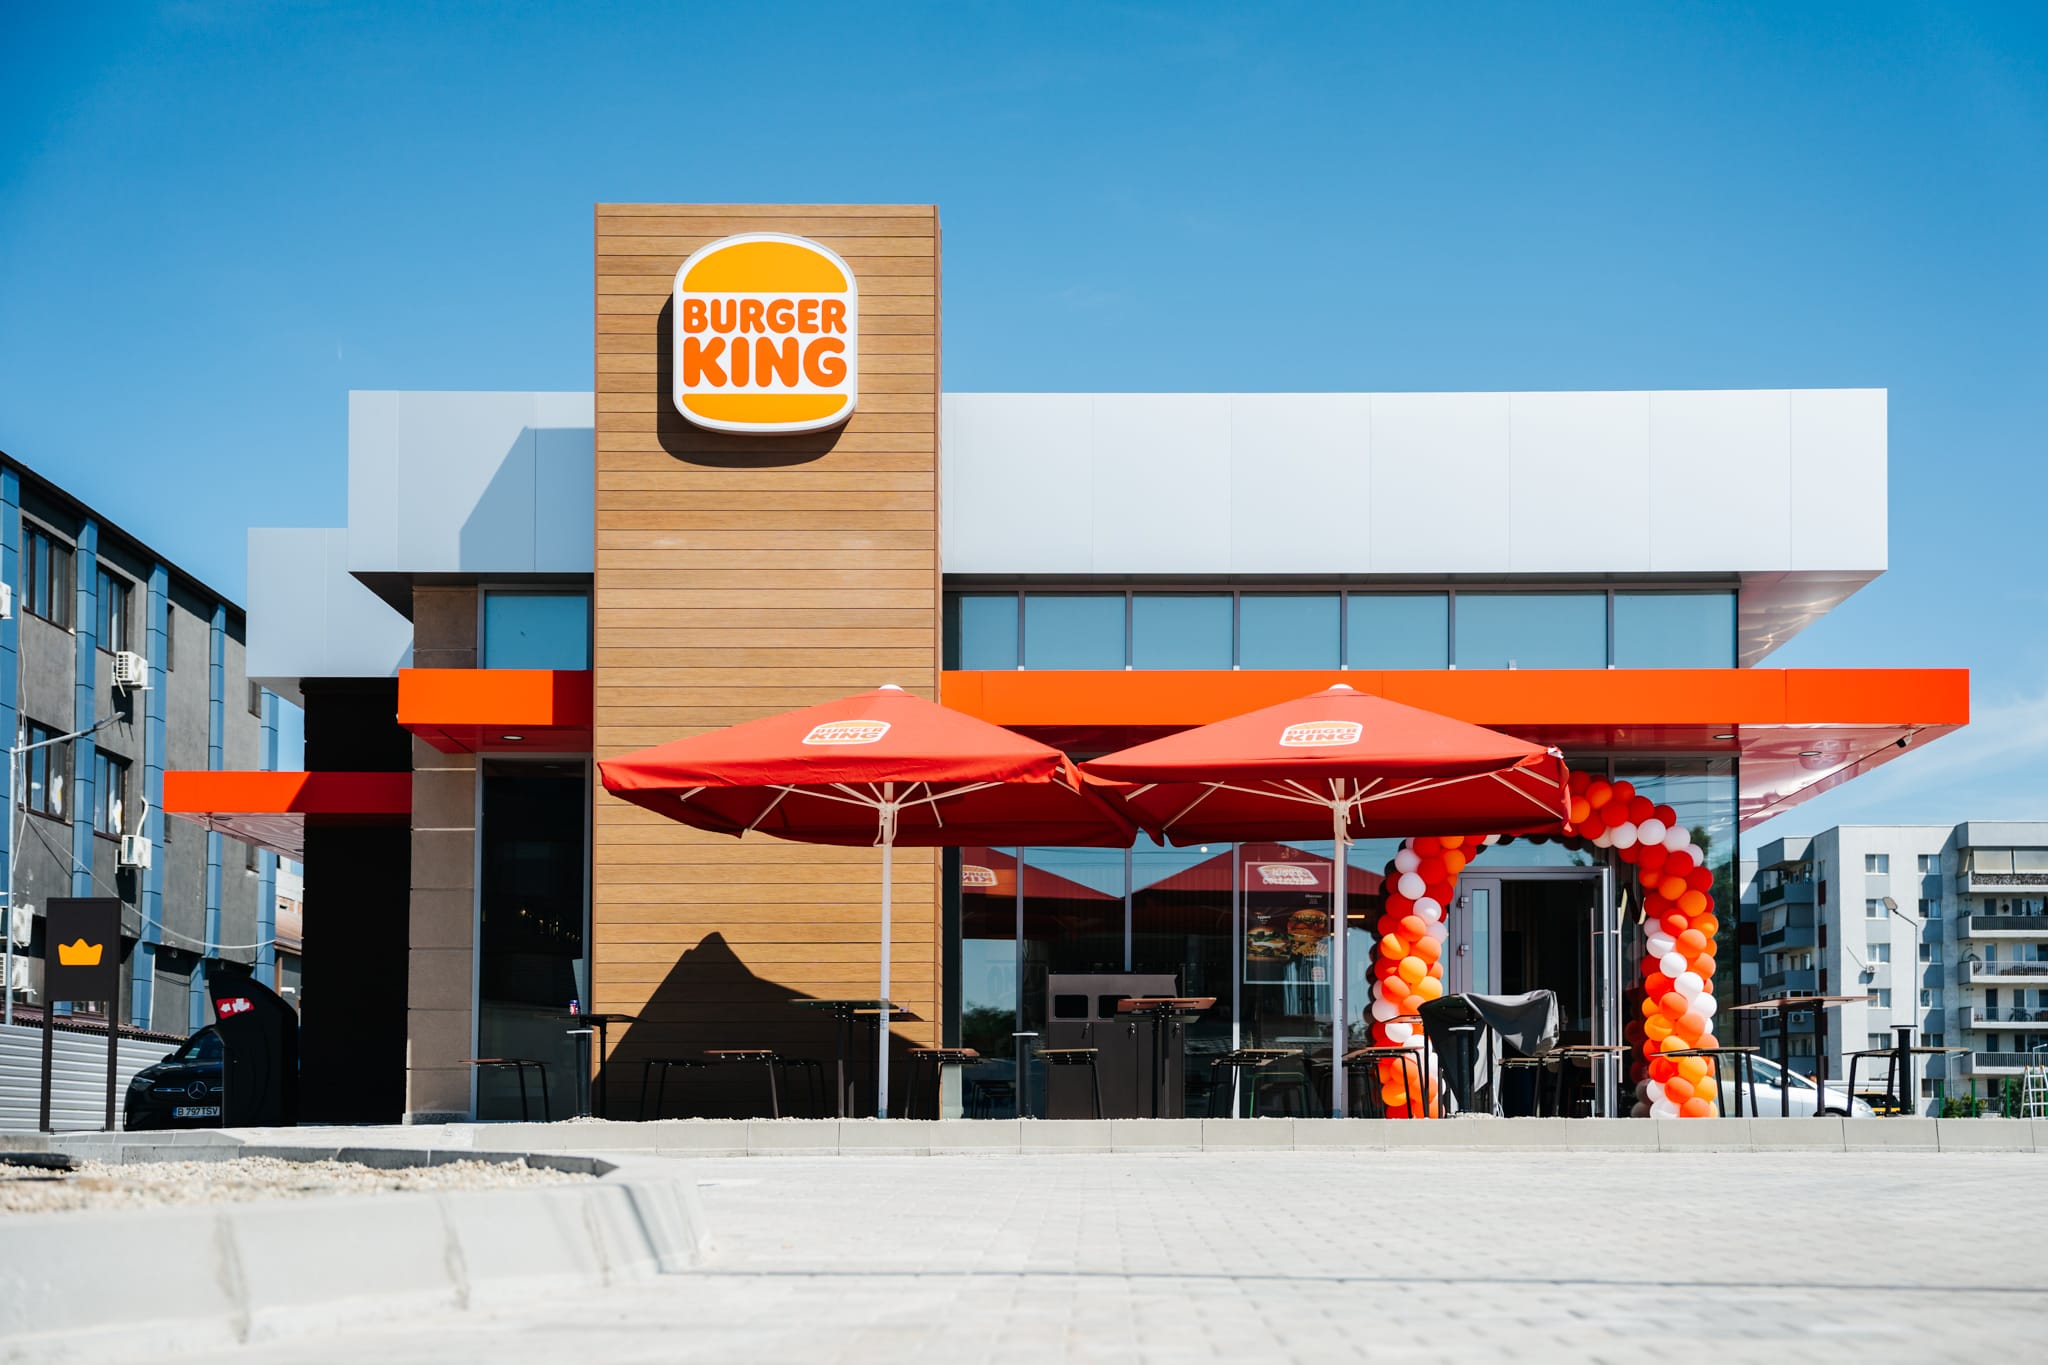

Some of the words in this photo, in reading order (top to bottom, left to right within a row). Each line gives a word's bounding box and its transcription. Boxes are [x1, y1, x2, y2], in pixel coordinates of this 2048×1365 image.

[683, 298, 847, 334] BURGER
[683, 336, 847, 388] KING
[808, 732, 881, 740] KING
[1285, 733, 1357, 742] KING
[177, 1107, 184, 1116] B
